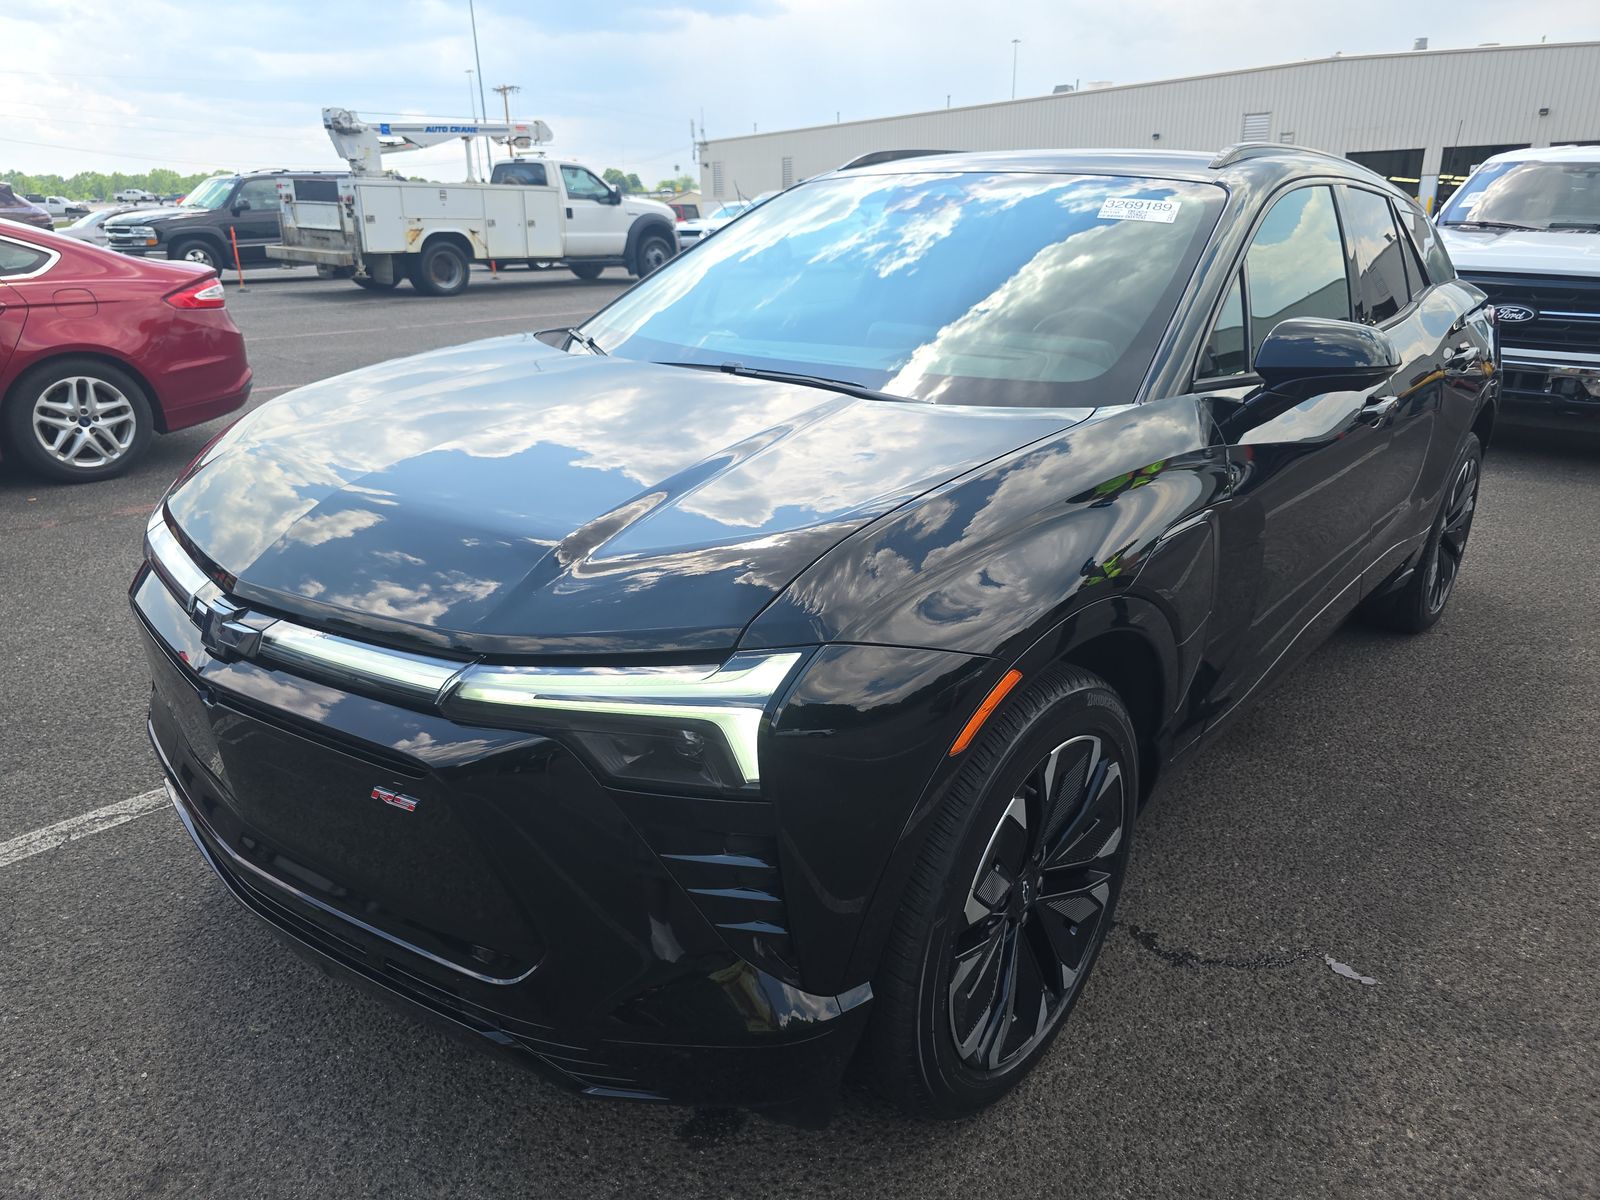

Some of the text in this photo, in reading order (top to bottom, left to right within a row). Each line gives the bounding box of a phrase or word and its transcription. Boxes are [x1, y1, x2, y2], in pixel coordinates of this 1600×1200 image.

[450, 126, 479, 134] CRANE
[1105, 200, 1173, 212] 3269189
[1497, 307, 1526, 320] Ford
[371, 786, 420, 812] RS
